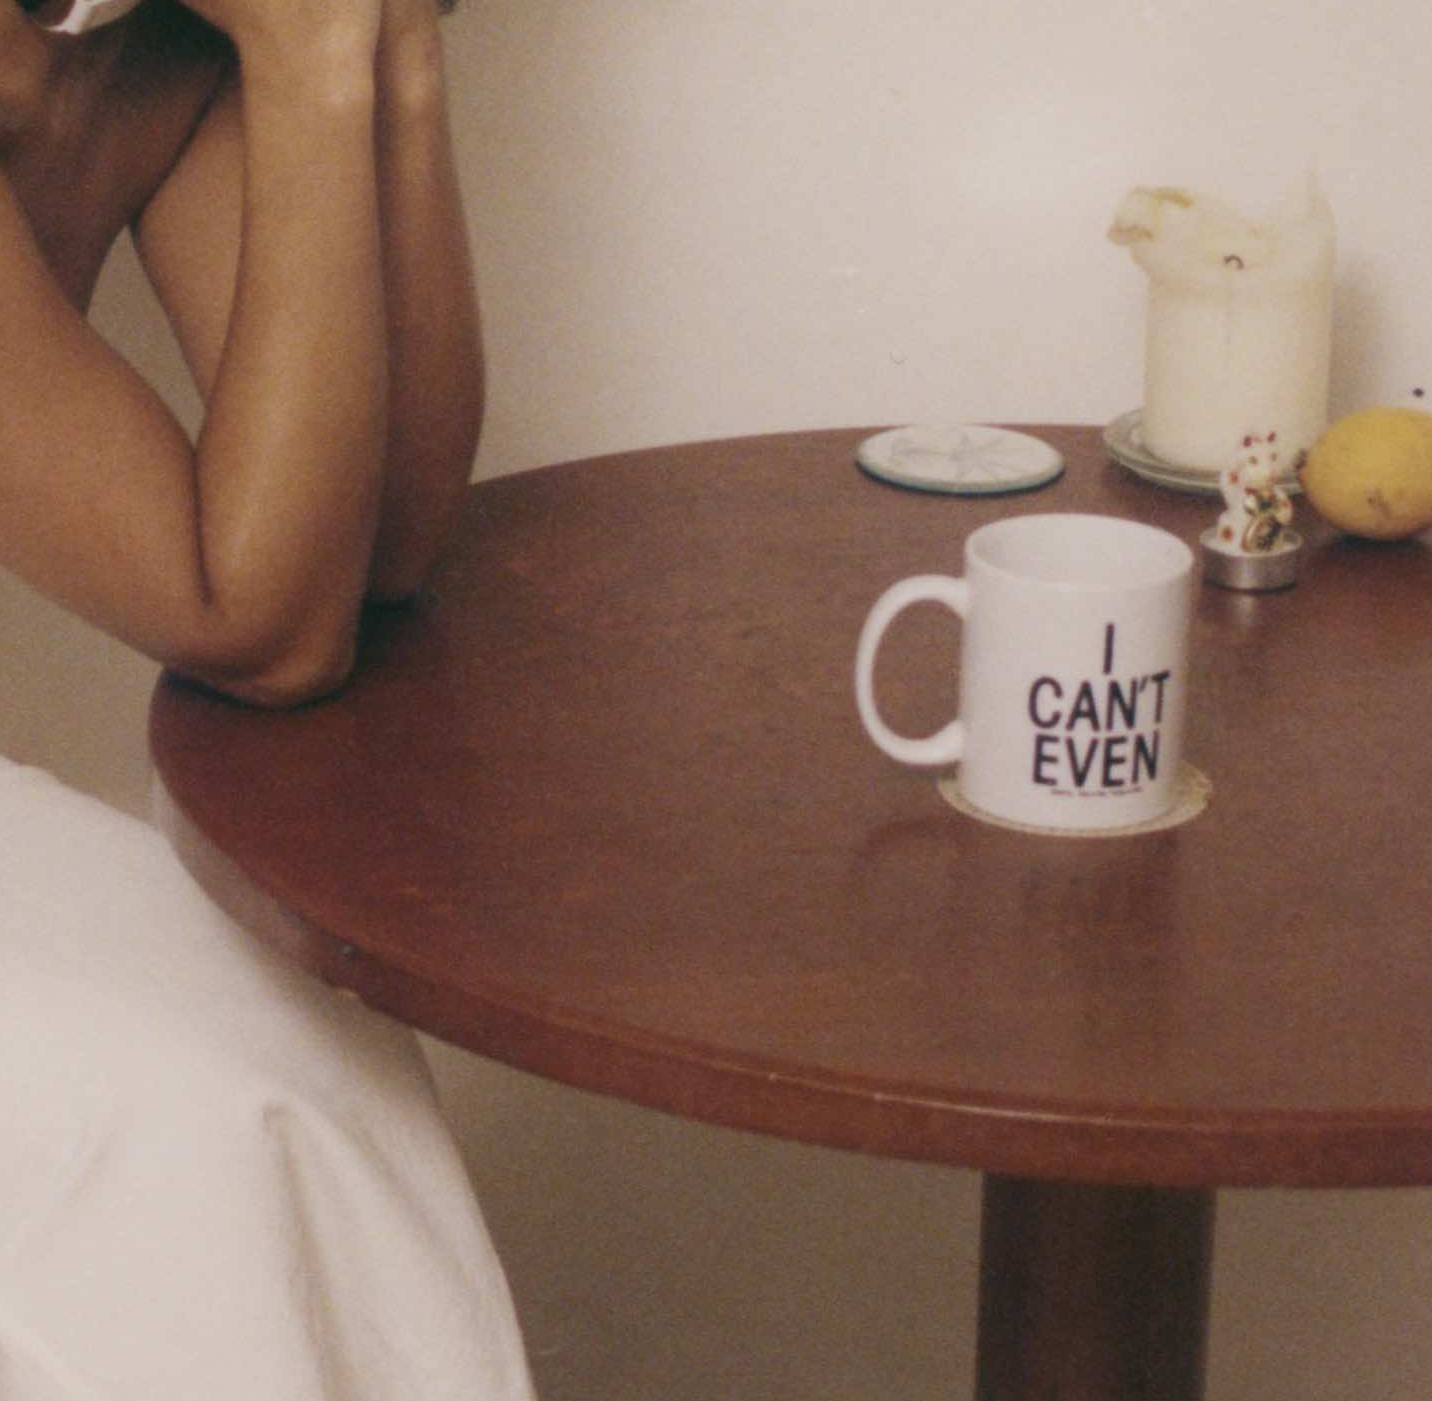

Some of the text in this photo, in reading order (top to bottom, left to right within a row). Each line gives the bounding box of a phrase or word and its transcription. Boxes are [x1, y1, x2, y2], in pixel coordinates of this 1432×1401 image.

[1102, 622, 1115, 675] I
[1027, 669, 1171, 731] CAN'T
[1032, 730, 1160, 788] EVEN
